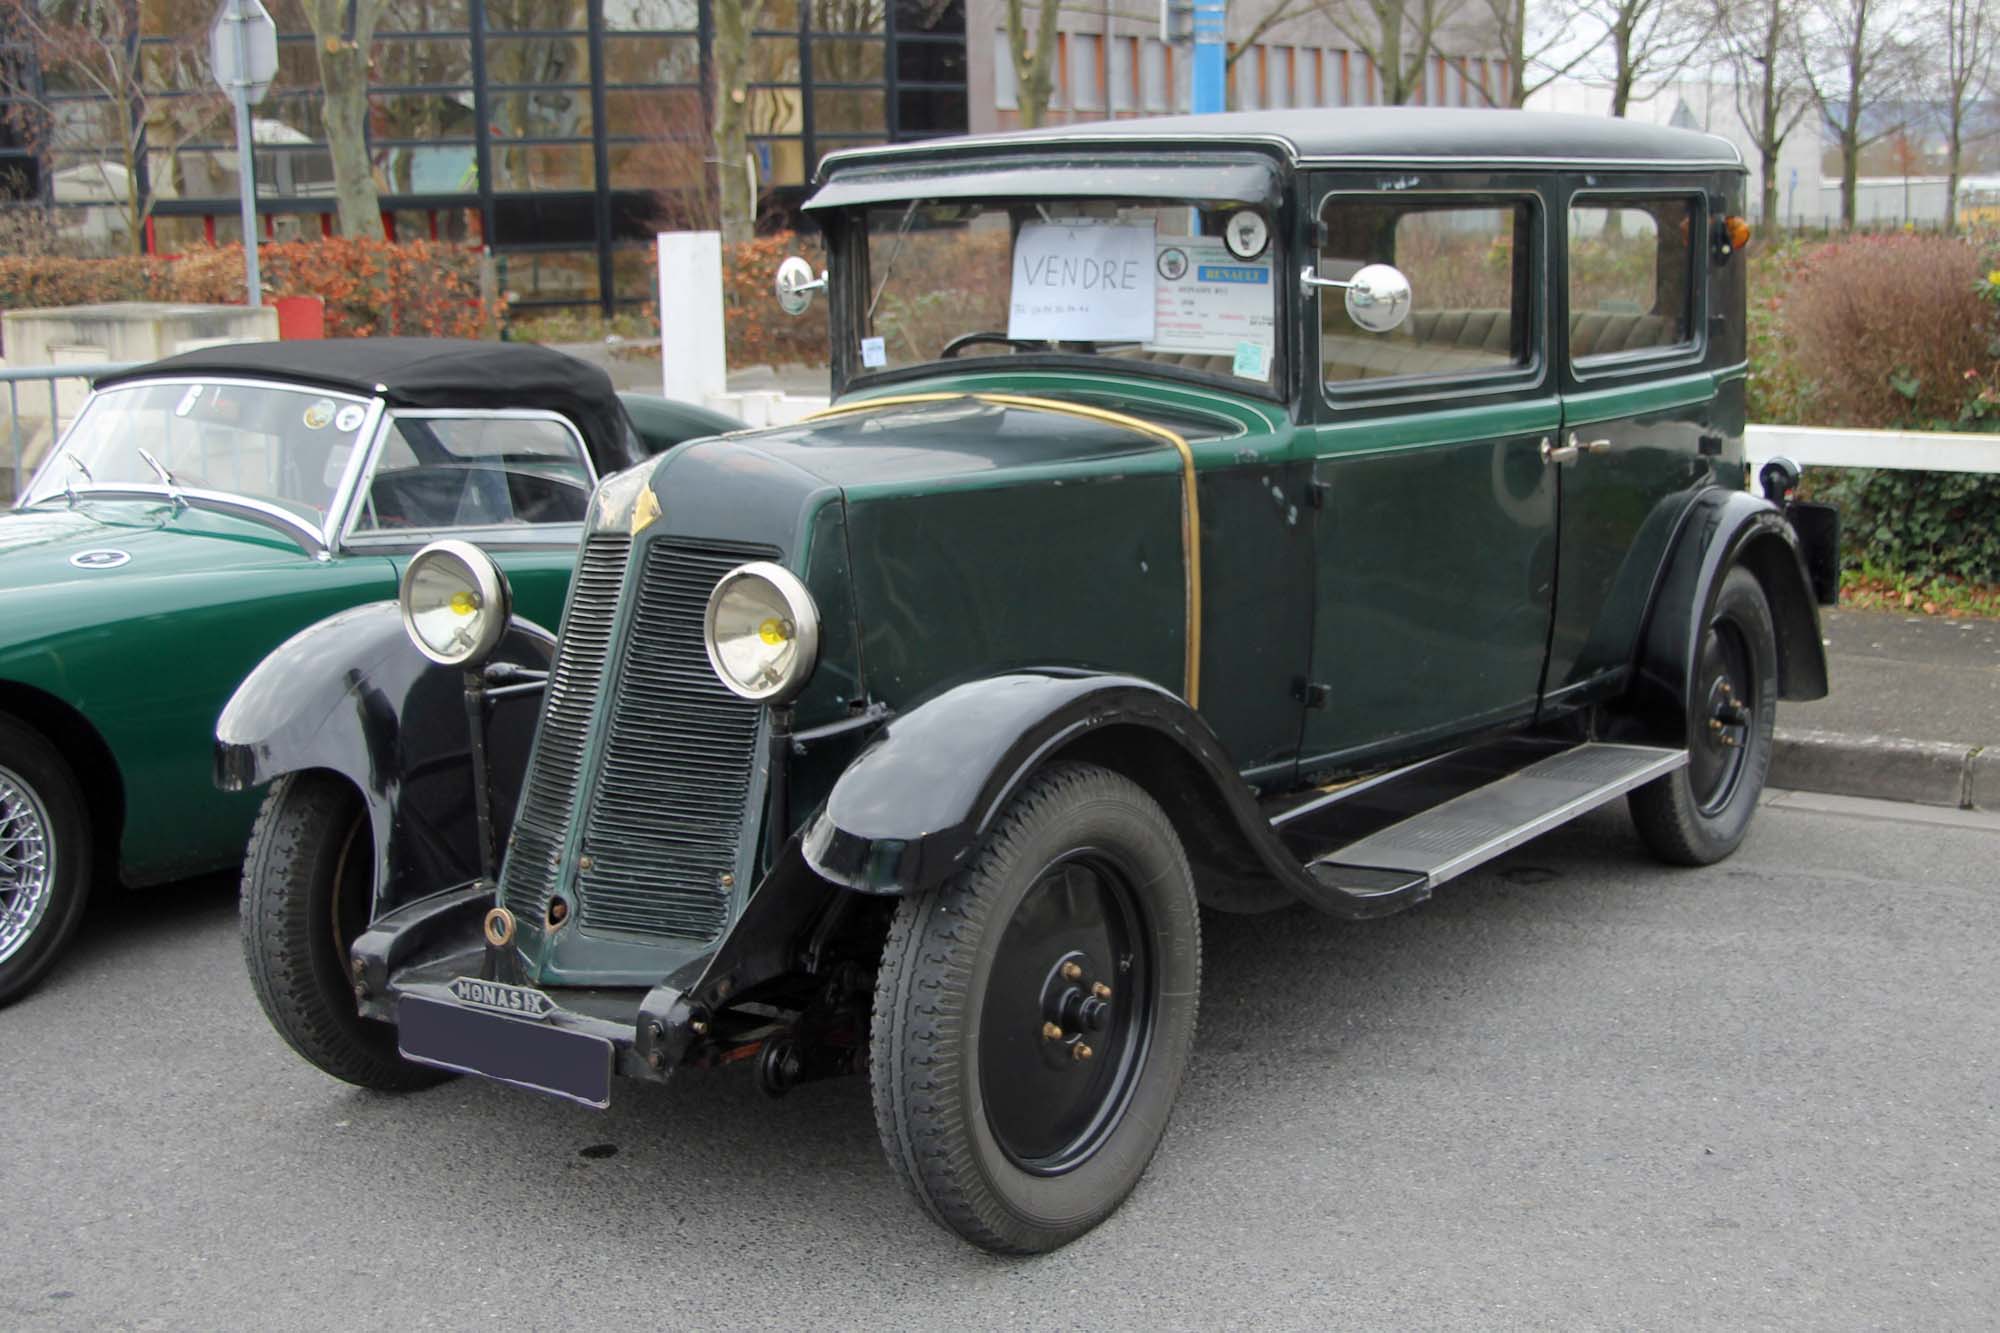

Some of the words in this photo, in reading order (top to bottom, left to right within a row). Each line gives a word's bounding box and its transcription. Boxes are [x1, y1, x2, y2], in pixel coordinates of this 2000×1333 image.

[1023, 254, 1139, 290] VENDRE
[1206, 268, 1261, 281] RENAULT
[458, 981, 543, 1014] MONASIX
